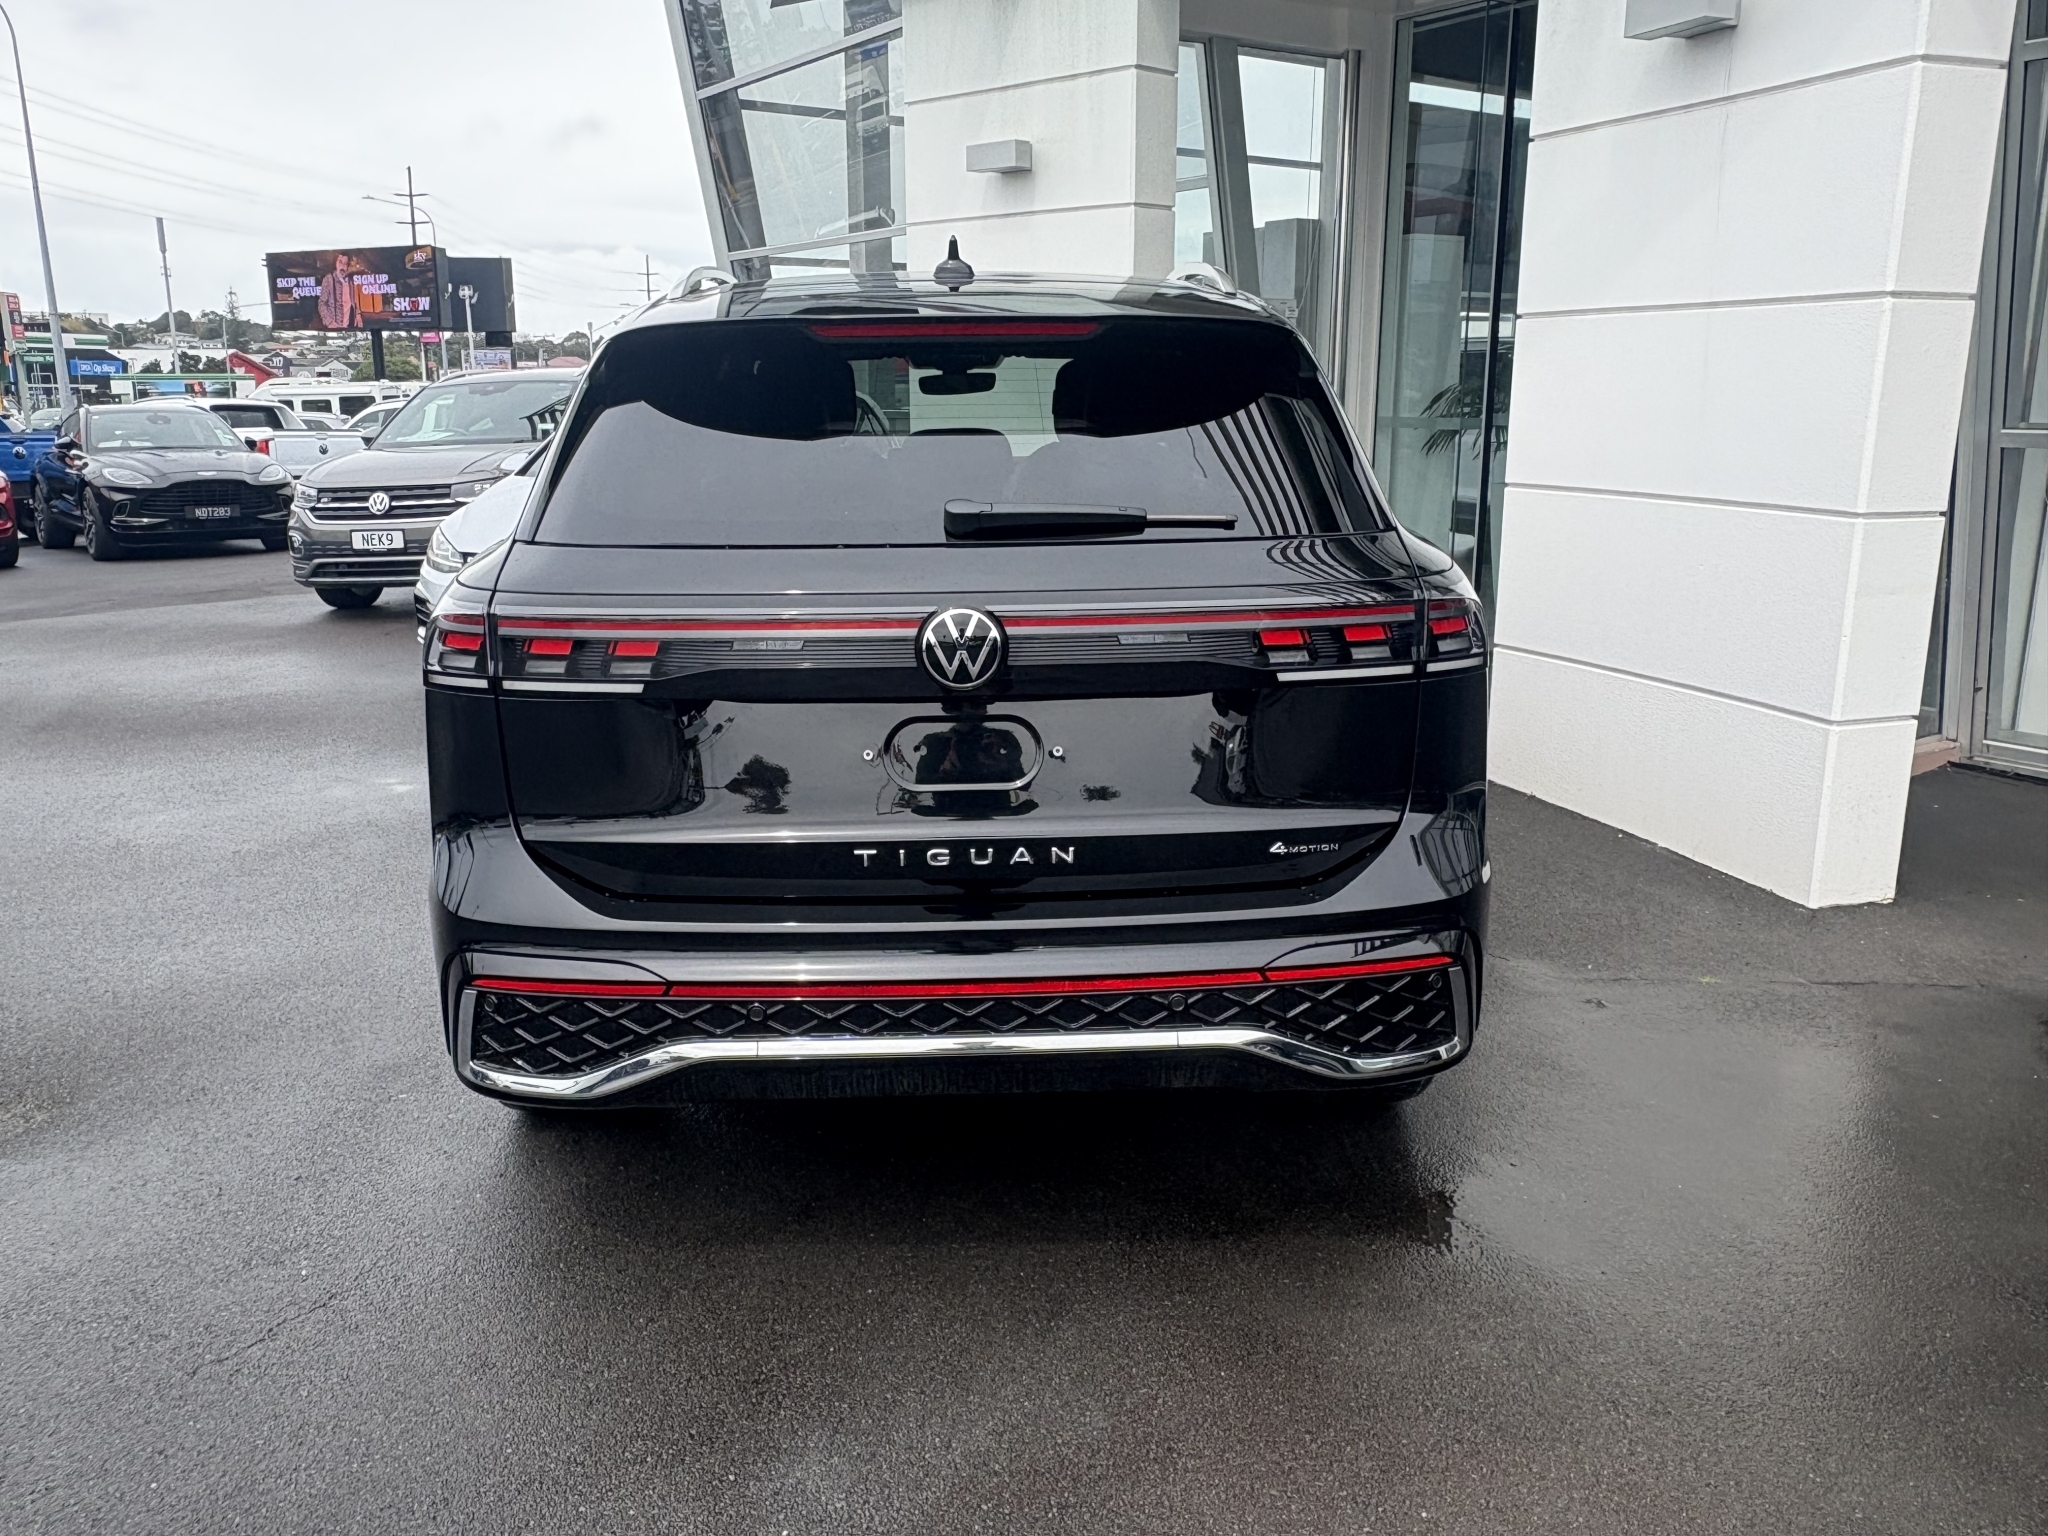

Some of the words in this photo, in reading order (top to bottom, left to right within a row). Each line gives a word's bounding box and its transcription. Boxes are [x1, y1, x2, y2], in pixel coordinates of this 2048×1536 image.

[276, 277, 297, 288] SKIP
[297, 276, 316, 287] THE
[353, 274, 376, 285] SIGN
[375, 273, 389, 284] UP
[292, 286, 322, 299] QUEUE
[361, 283, 397, 295] ONLINE
[101, 363, 116, 374] Shop
[361, 533, 394, 547] NEK9
[1269, 841, 1339, 855] 4MOTION
[853, 846, 1075, 867] TIGUAN
